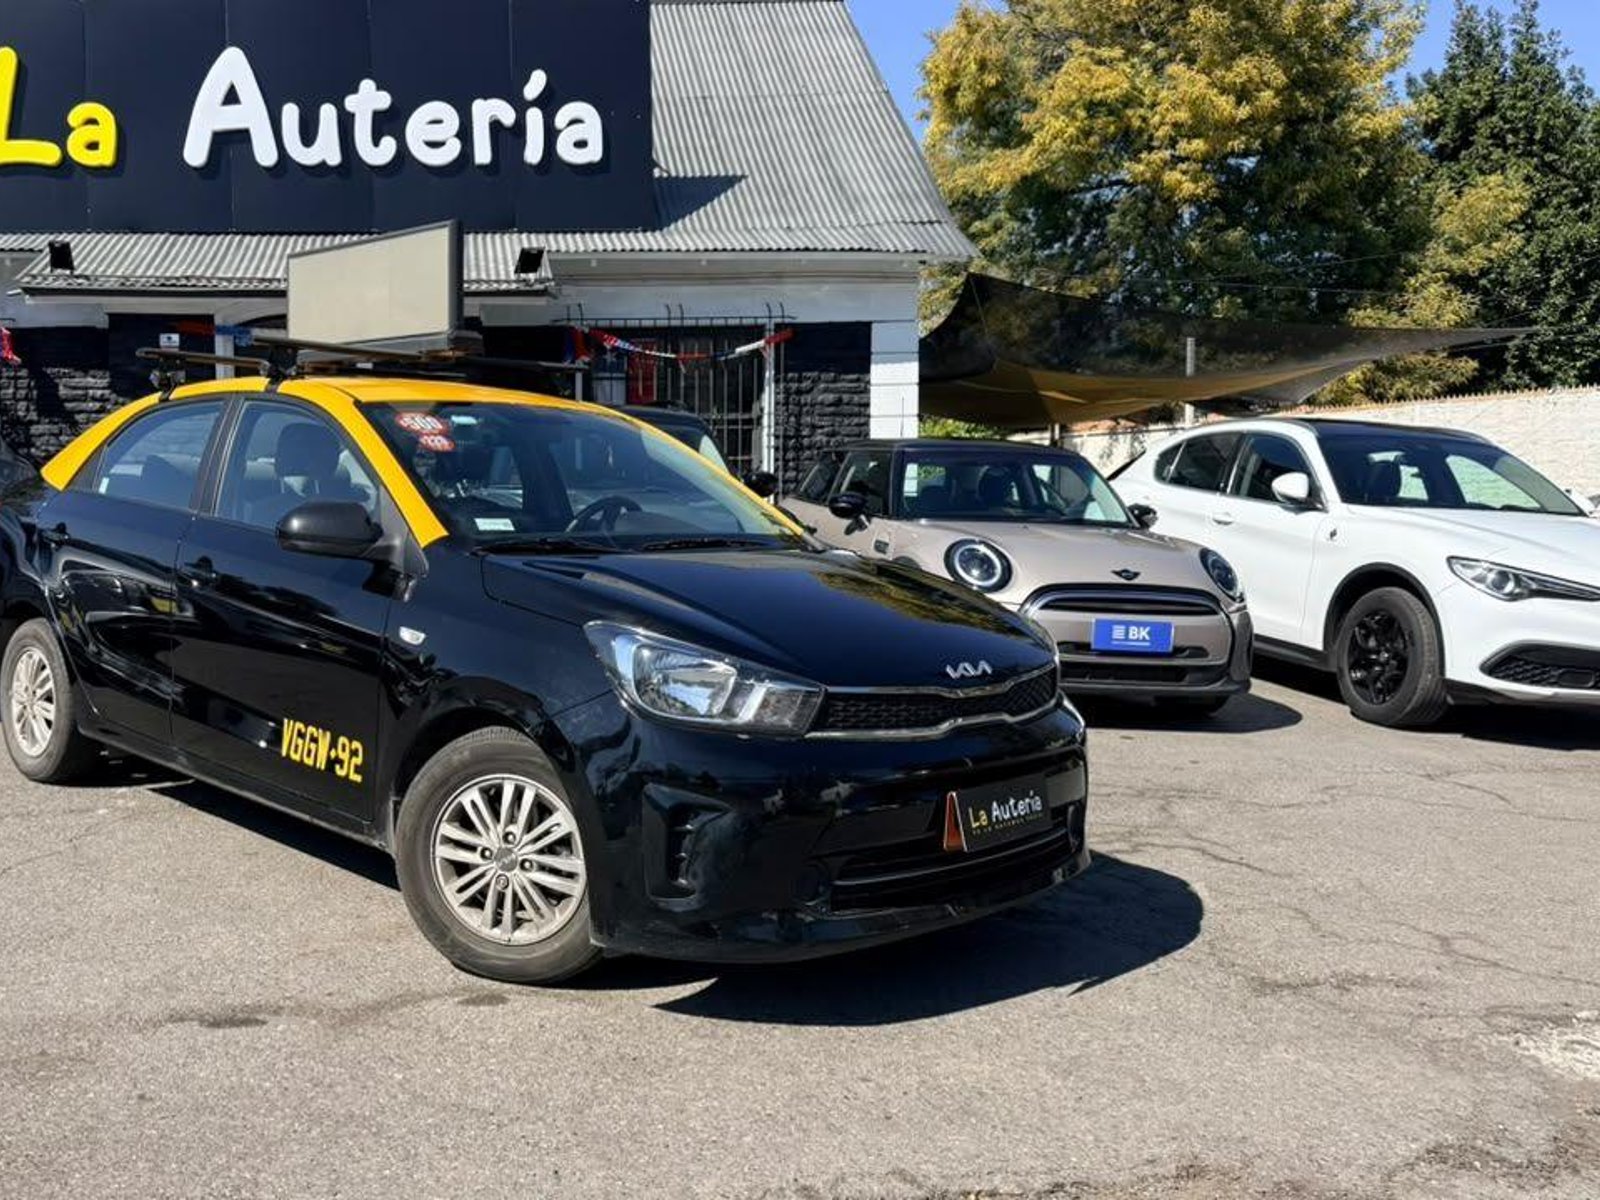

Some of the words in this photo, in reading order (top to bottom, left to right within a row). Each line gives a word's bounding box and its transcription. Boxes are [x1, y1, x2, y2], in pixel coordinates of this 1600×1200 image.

[0, 46, 117, 167] La
[182, 46, 603, 168] Autería
[1128, 625, 1151, 641] BK
[968, 806, 989, 829] La
[990, 789, 1043, 823] Autería
